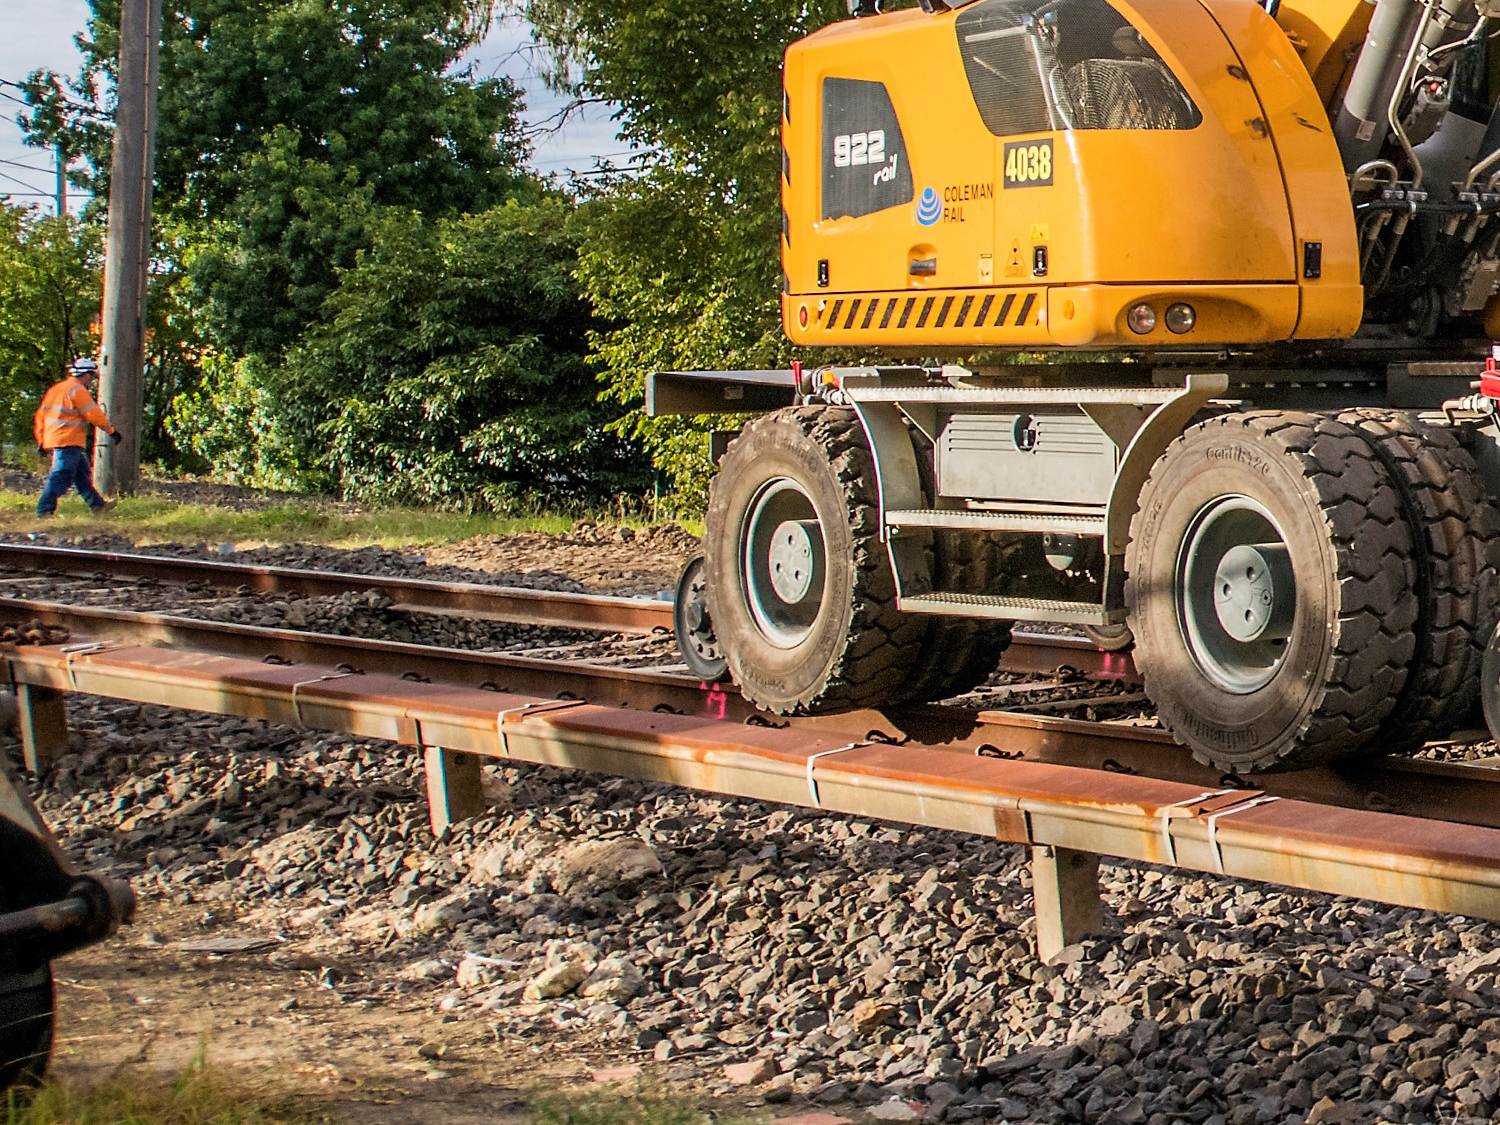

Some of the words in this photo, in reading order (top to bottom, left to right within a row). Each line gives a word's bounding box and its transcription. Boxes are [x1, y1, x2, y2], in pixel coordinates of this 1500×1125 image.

[834, 129, 886, 168] 922
[1005, 144, 1052, 183] 4038
[873, 153, 898, 186] rail
[944, 183, 994, 203] COLEMAN
[944, 207, 965, 224] RAIL
